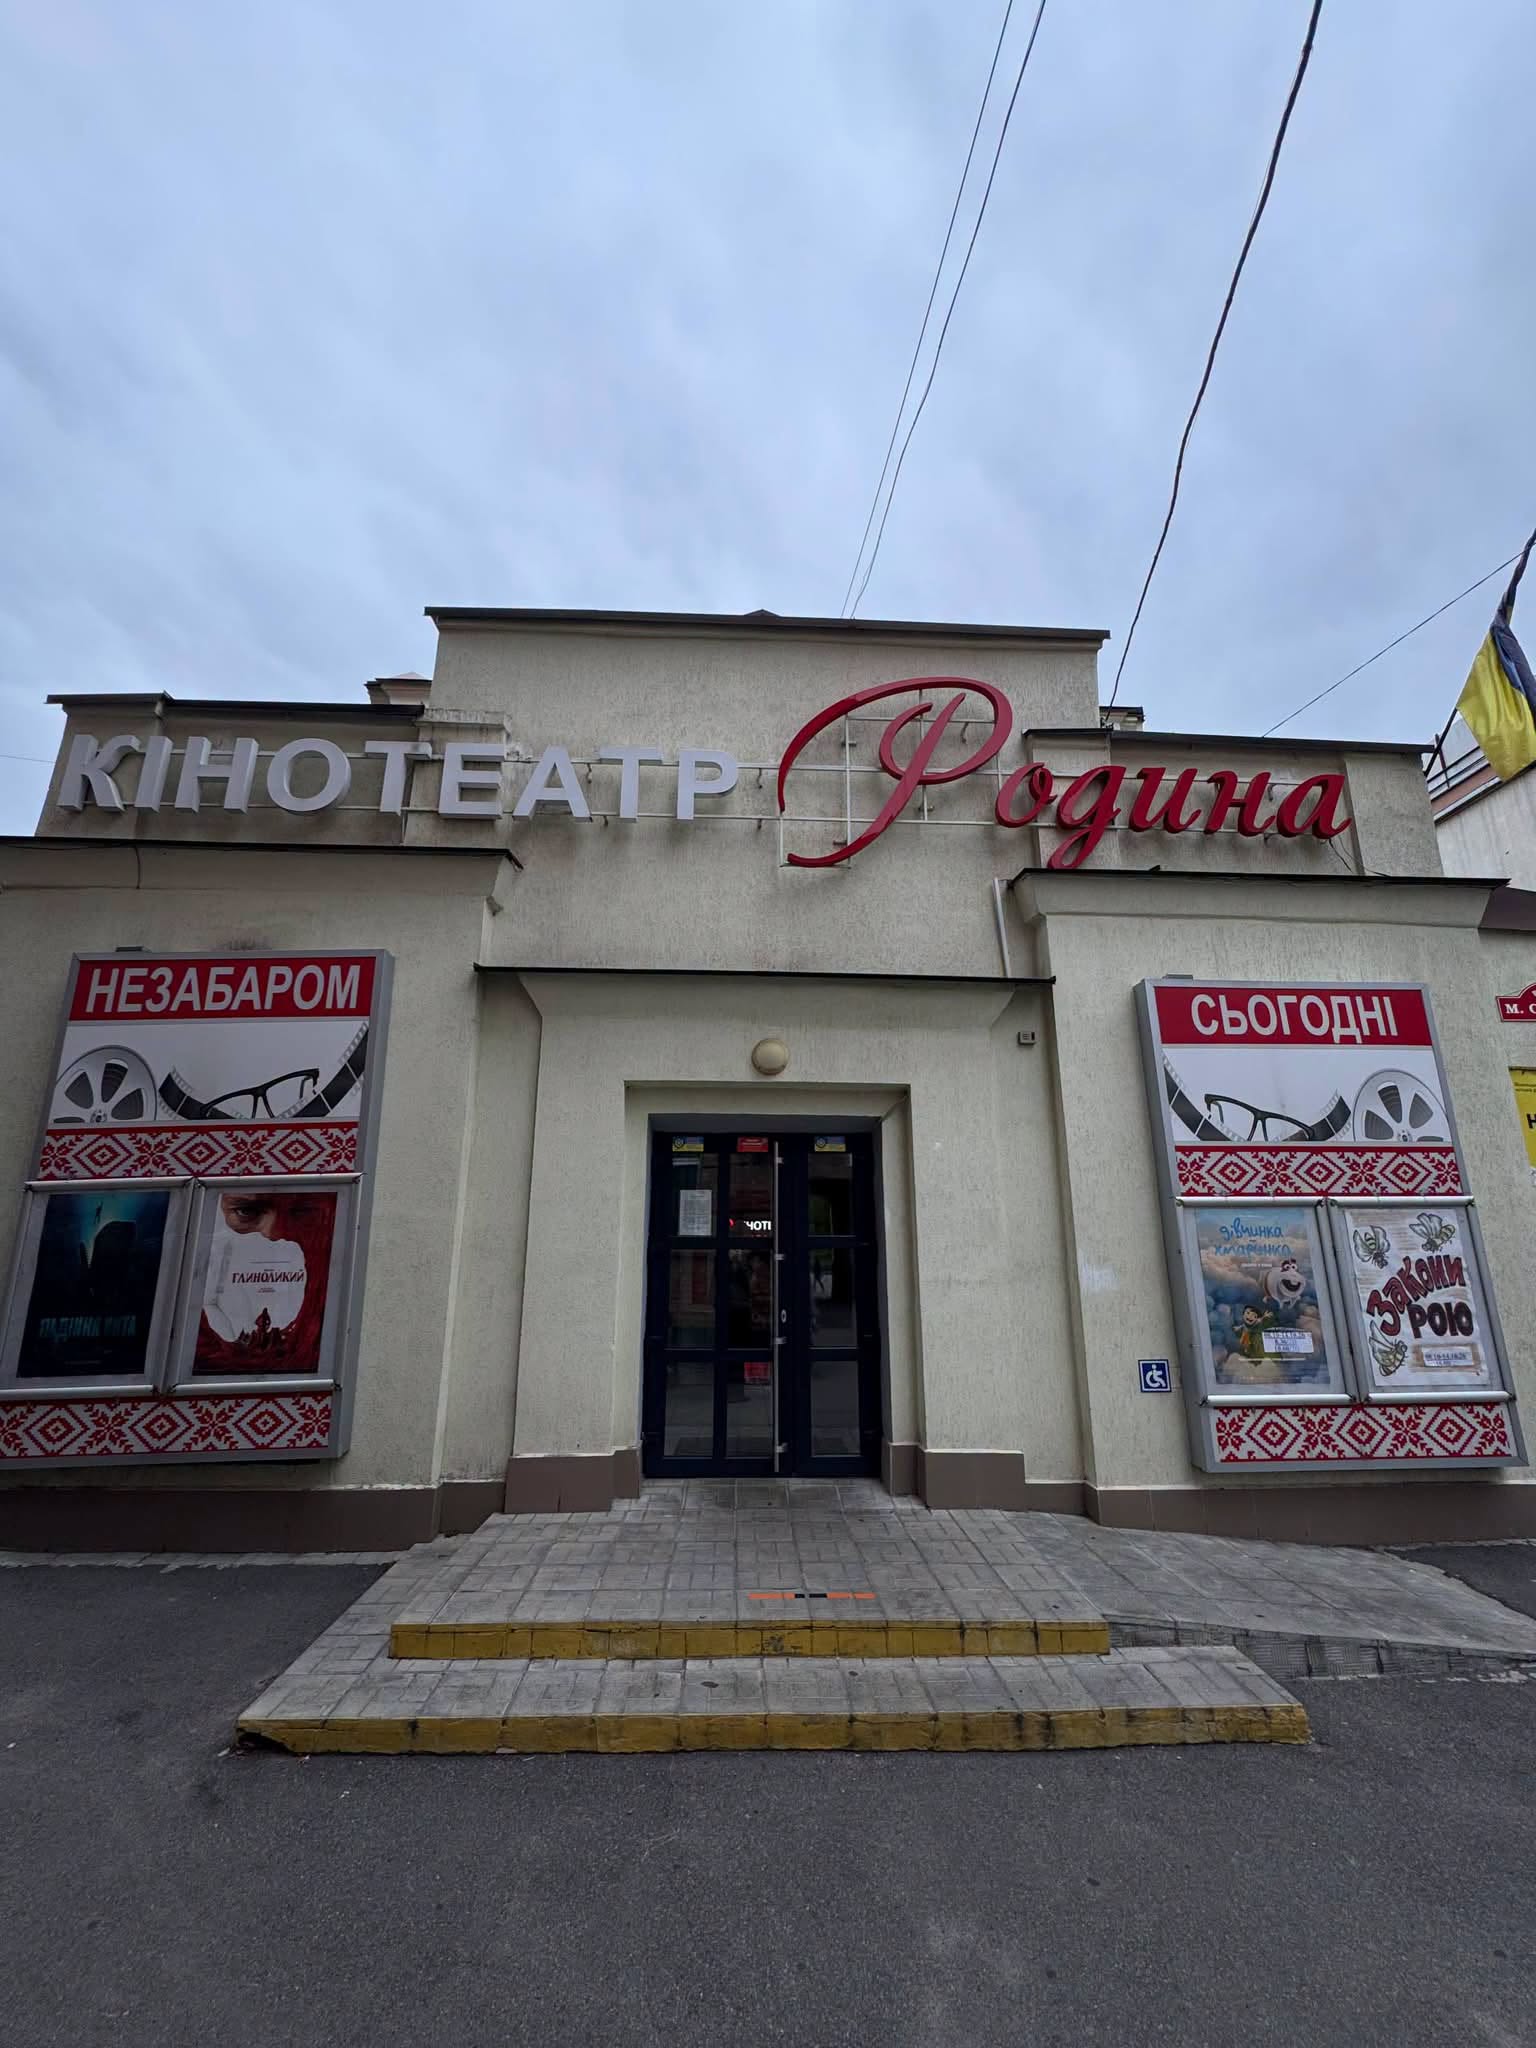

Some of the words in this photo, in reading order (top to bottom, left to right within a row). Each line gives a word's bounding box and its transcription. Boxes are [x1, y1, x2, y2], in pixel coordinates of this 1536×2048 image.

[57, 734, 740, 821] КІНОТЕАТР
[778, 676, 1352, 869] Родина
[85, 964, 361, 1013] НЕЗАБАРОМ
[1191, 993, 1398, 1044] СЬОГОДНІ
[231, 1268, 304, 1283] ГЛИНОЛИКИЙ
